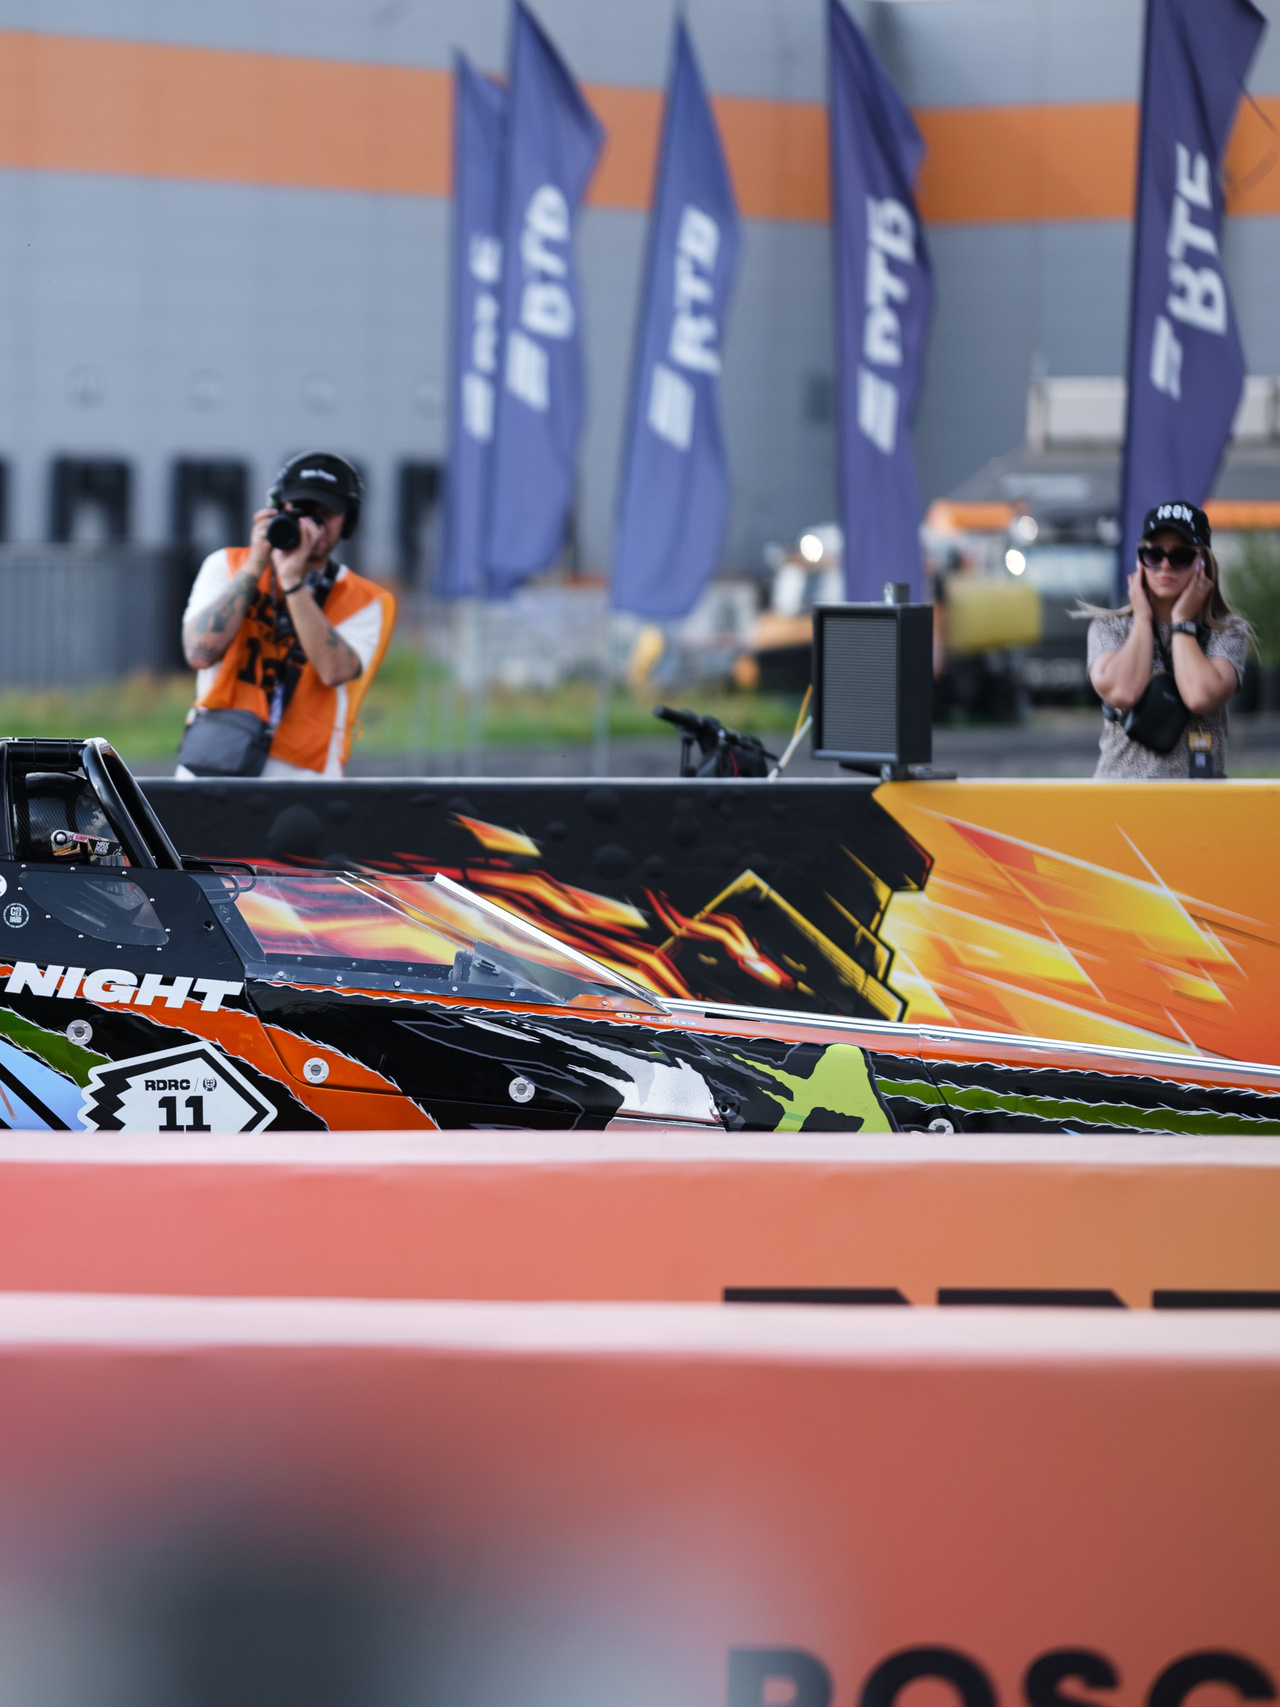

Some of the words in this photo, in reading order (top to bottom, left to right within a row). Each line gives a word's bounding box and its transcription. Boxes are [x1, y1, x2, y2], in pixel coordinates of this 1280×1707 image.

[4, 961, 244, 1012] NIGHT
[144, 1079, 191, 1091] RDRC
[158, 1095, 211, 1134] 11
